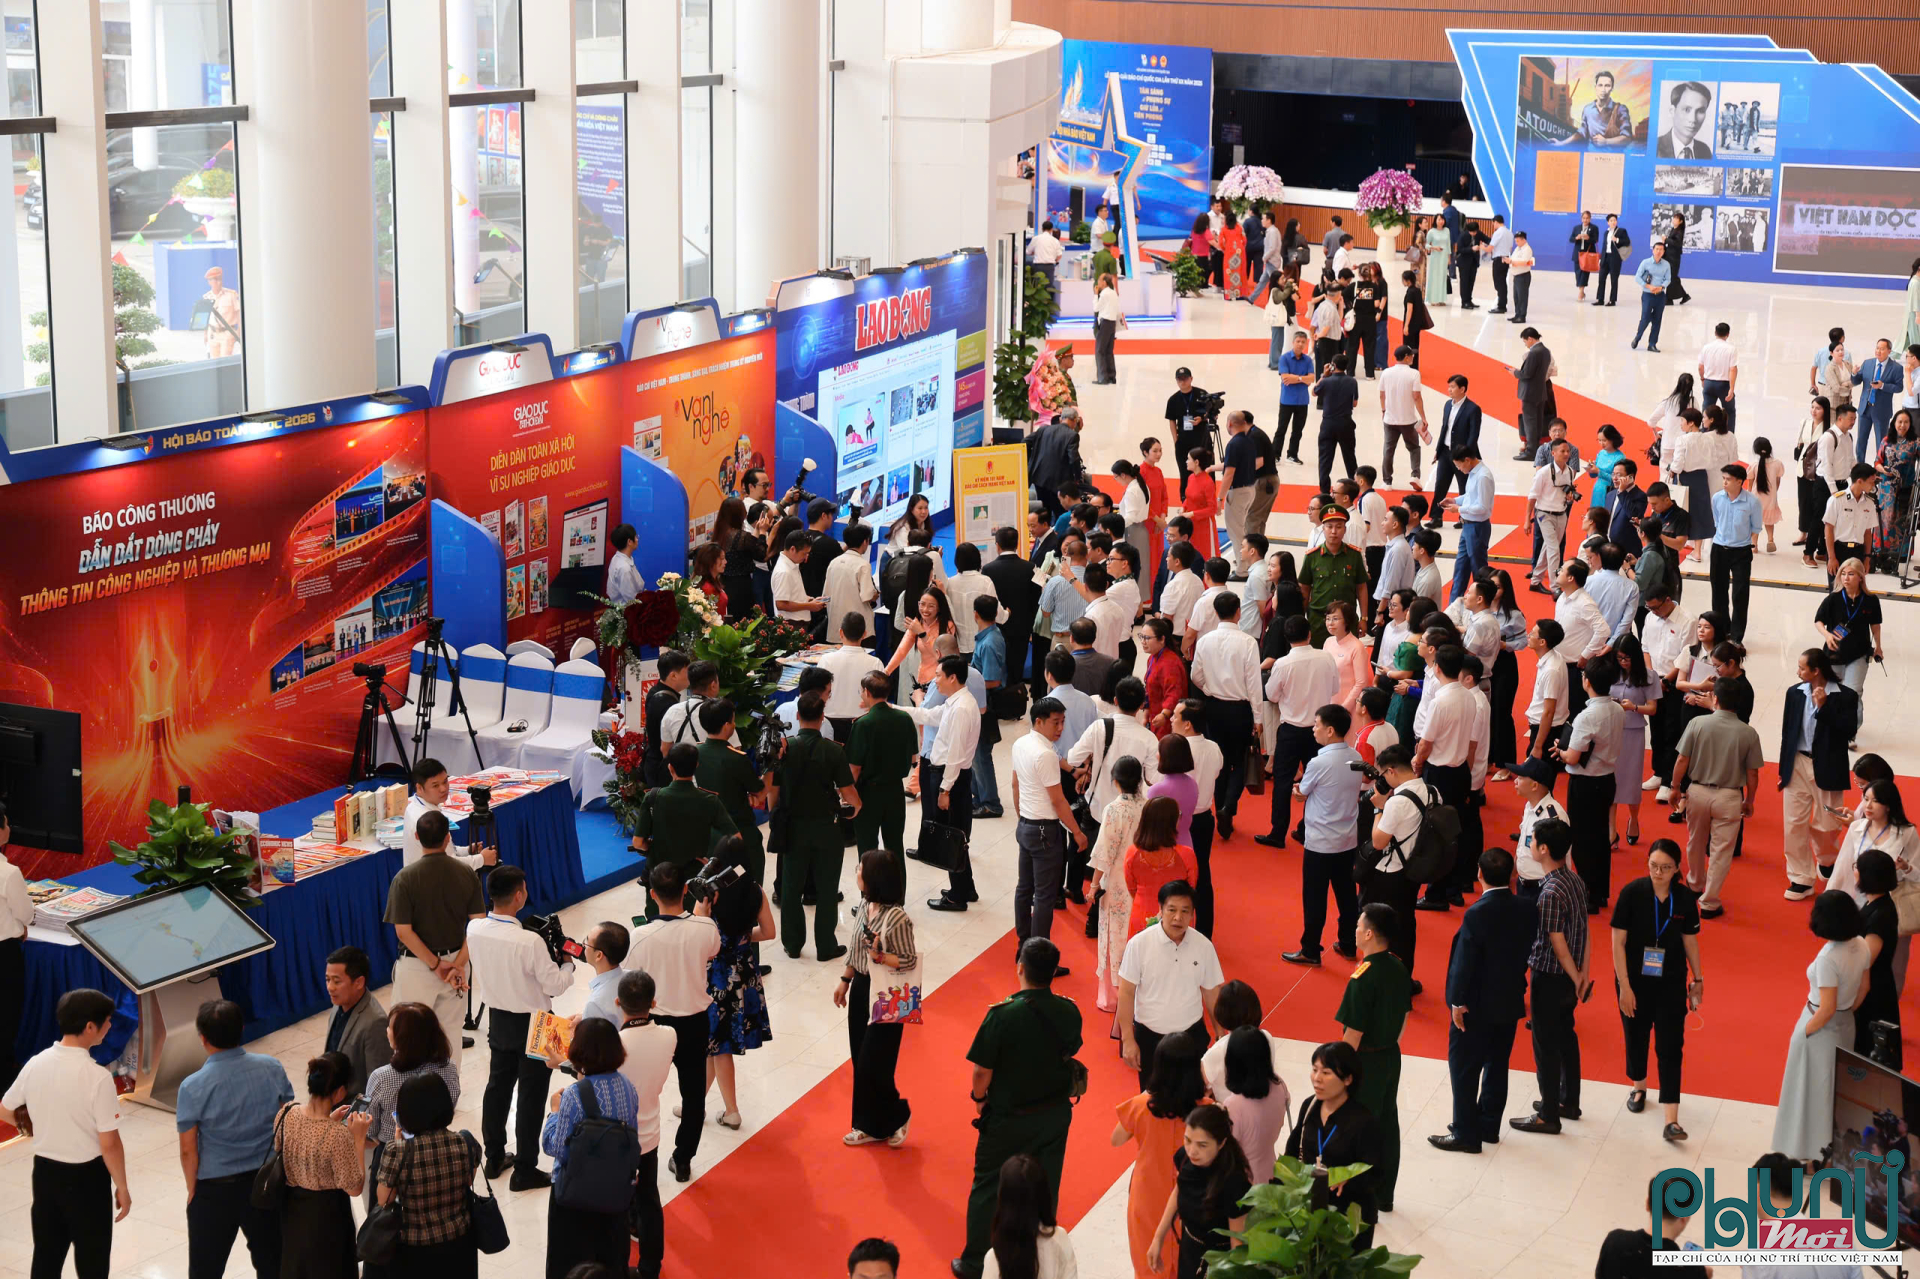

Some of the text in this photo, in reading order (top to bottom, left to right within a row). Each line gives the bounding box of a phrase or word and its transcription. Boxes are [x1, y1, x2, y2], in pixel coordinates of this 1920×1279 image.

[1799, 207, 1917, 231] VIỆT NAM ĐỘC
[855, 287, 931, 351] LAO ĐỘNG
[163, 433, 184, 449] HỘI
[186, 430, 212, 445] BÁO
[285, 413, 316, 427] 2026
[491, 450, 508, 471] DIỄN
[510, 447, 526, 466] ĐÀN
[527, 442, 548, 461] TOÀN
[561, 433, 575, 453] HỘI
[490, 475, 498, 493] VÌ
[511, 465, 540, 487] NGHIỆP
[541, 460, 559, 479] GIÁO
[561, 456, 576, 474] DỤC
[83, 490, 216, 535] BÁO CÔNG THƯƠNG
[78, 518, 220, 574] DẪN DẮT DÒNG CHẢY
[20, 587, 68, 616] THÔNG
[71, 580, 94, 604] TIN
[96, 572, 132, 600] CÔNG
[134, 560, 180, 590] NGHIỆP
[183, 554, 199, 580] VÀ
[201, 546, 247, 573] THƯƠNG
[249, 541, 271, 566] MẠI
